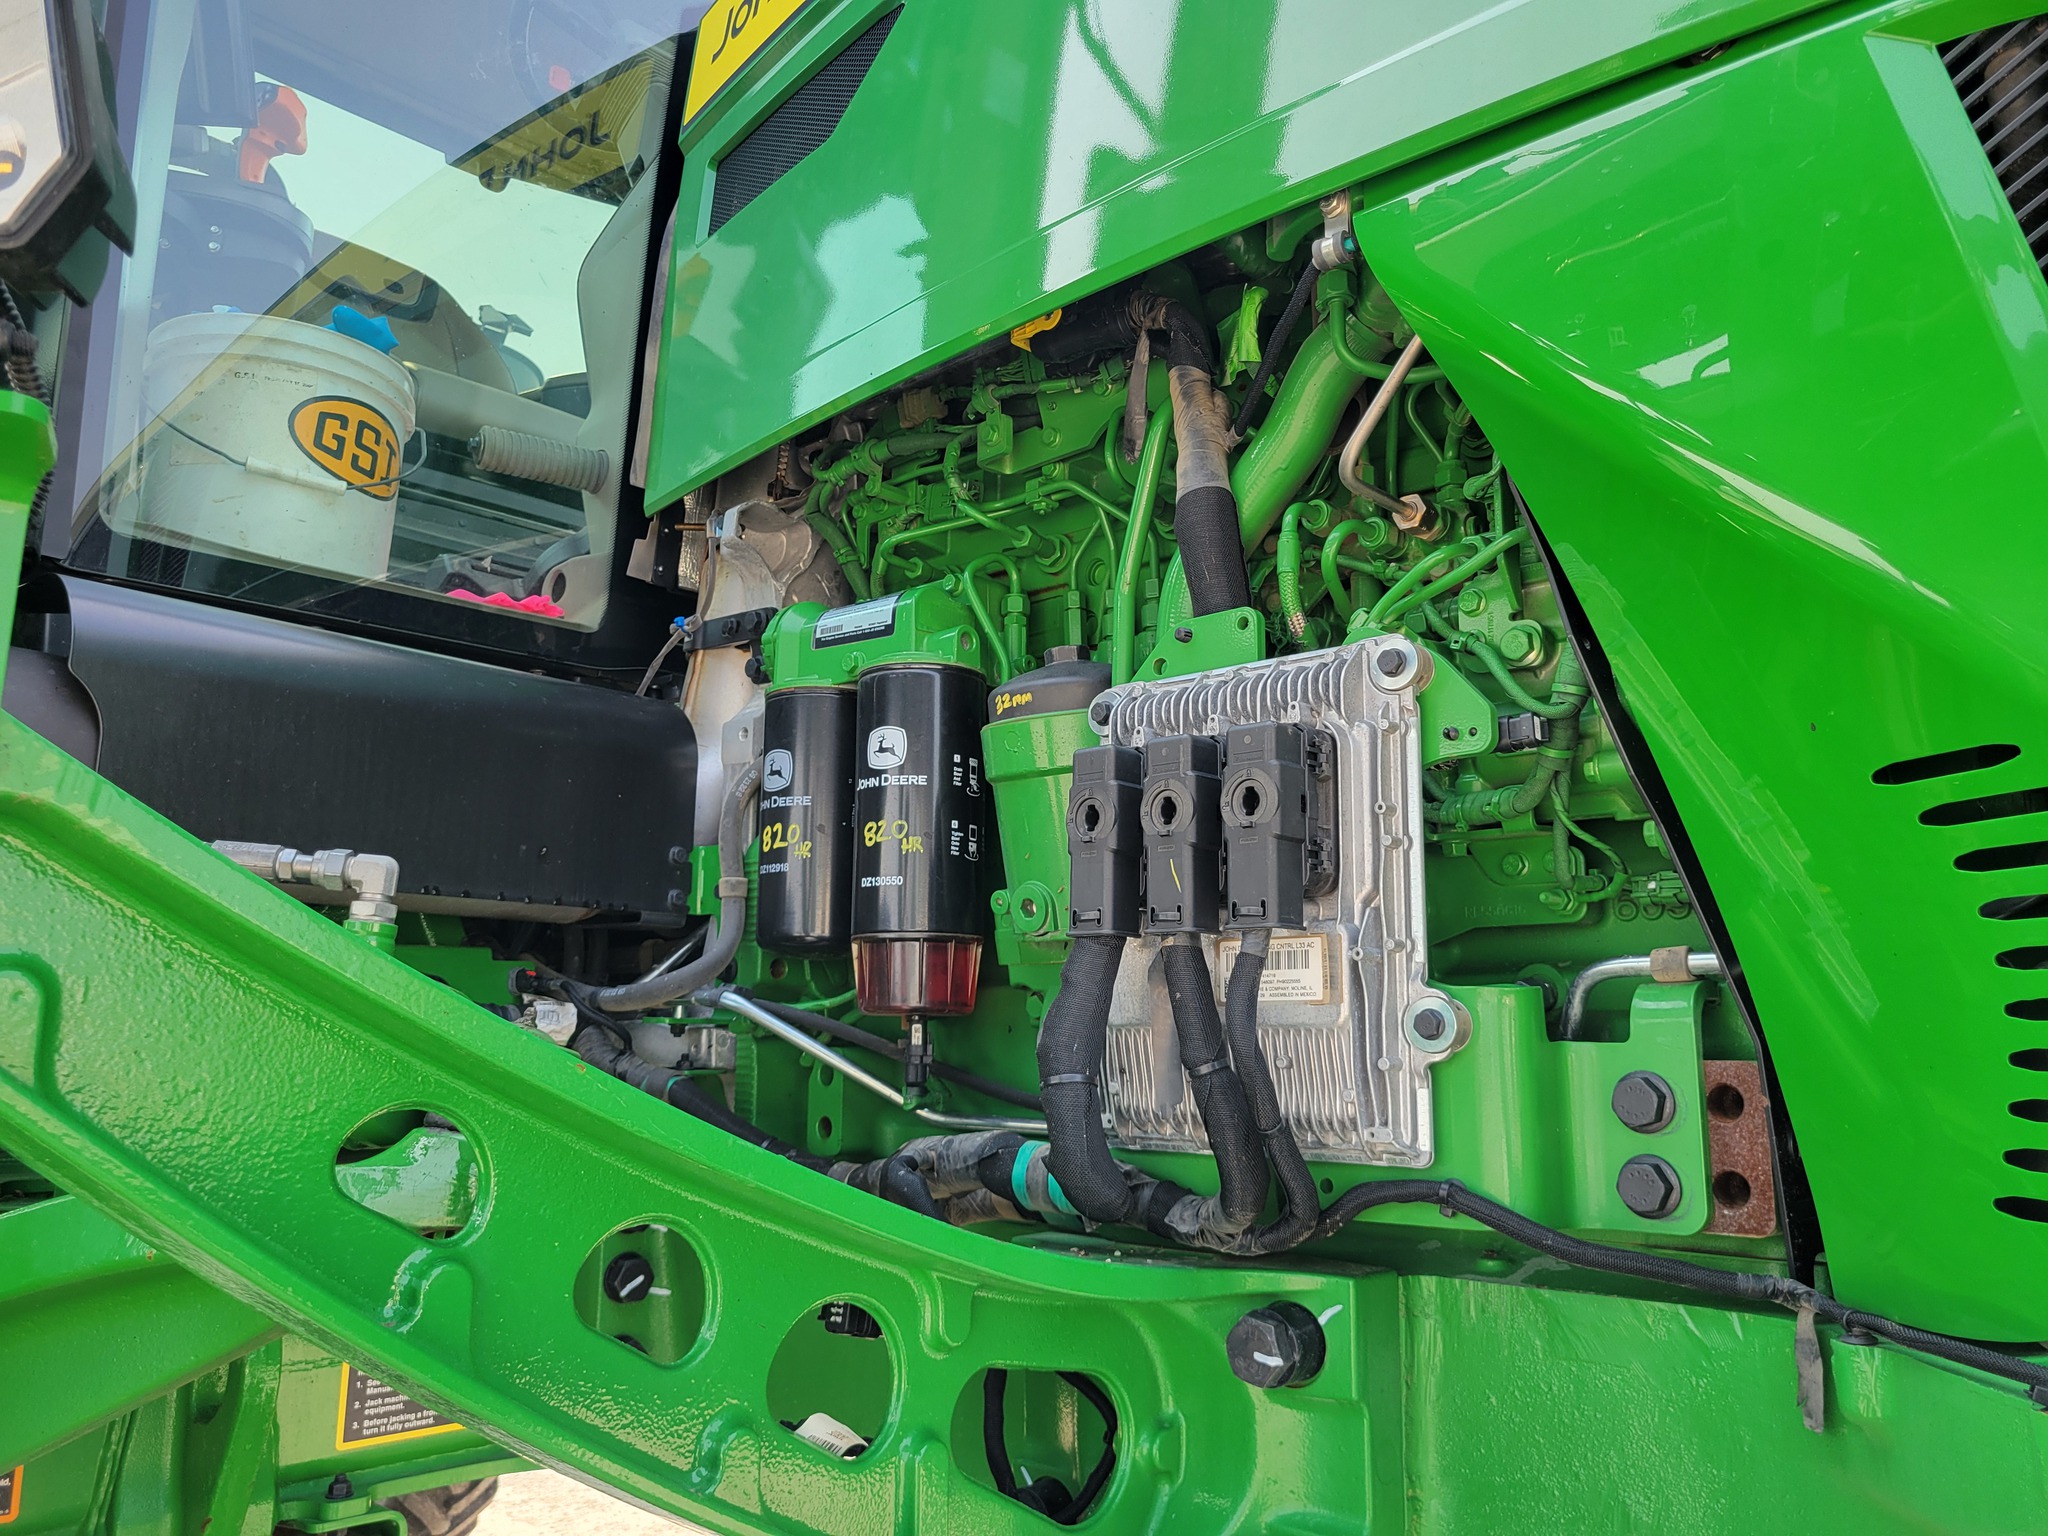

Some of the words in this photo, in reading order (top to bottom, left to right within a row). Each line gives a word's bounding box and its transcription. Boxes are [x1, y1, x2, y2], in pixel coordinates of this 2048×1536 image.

[313, 411, 397, 487] GSI
[857, 776, 879, 791] JOHN
[881, 774, 928, 787] DEERE
[771, 795, 812, 809] DEERE
[762, 822, 800, 853] 820
[864, 819, 909, 848] 820
[861, 875, 904, 888] DZ130550
[1306, 941, 1316, 949] AC
[364, 1397, 383, 1407] Jack
[364, 1403, 406, 1415] equipment.
[362, 1427, 379, 1436] turn
[387, 1422, 402, 1431] fully
[404, 1416, 435, 1428] outward.
[363, 1417, 389, 1428] Before
[388, 1412, 416, 1424] jacking
